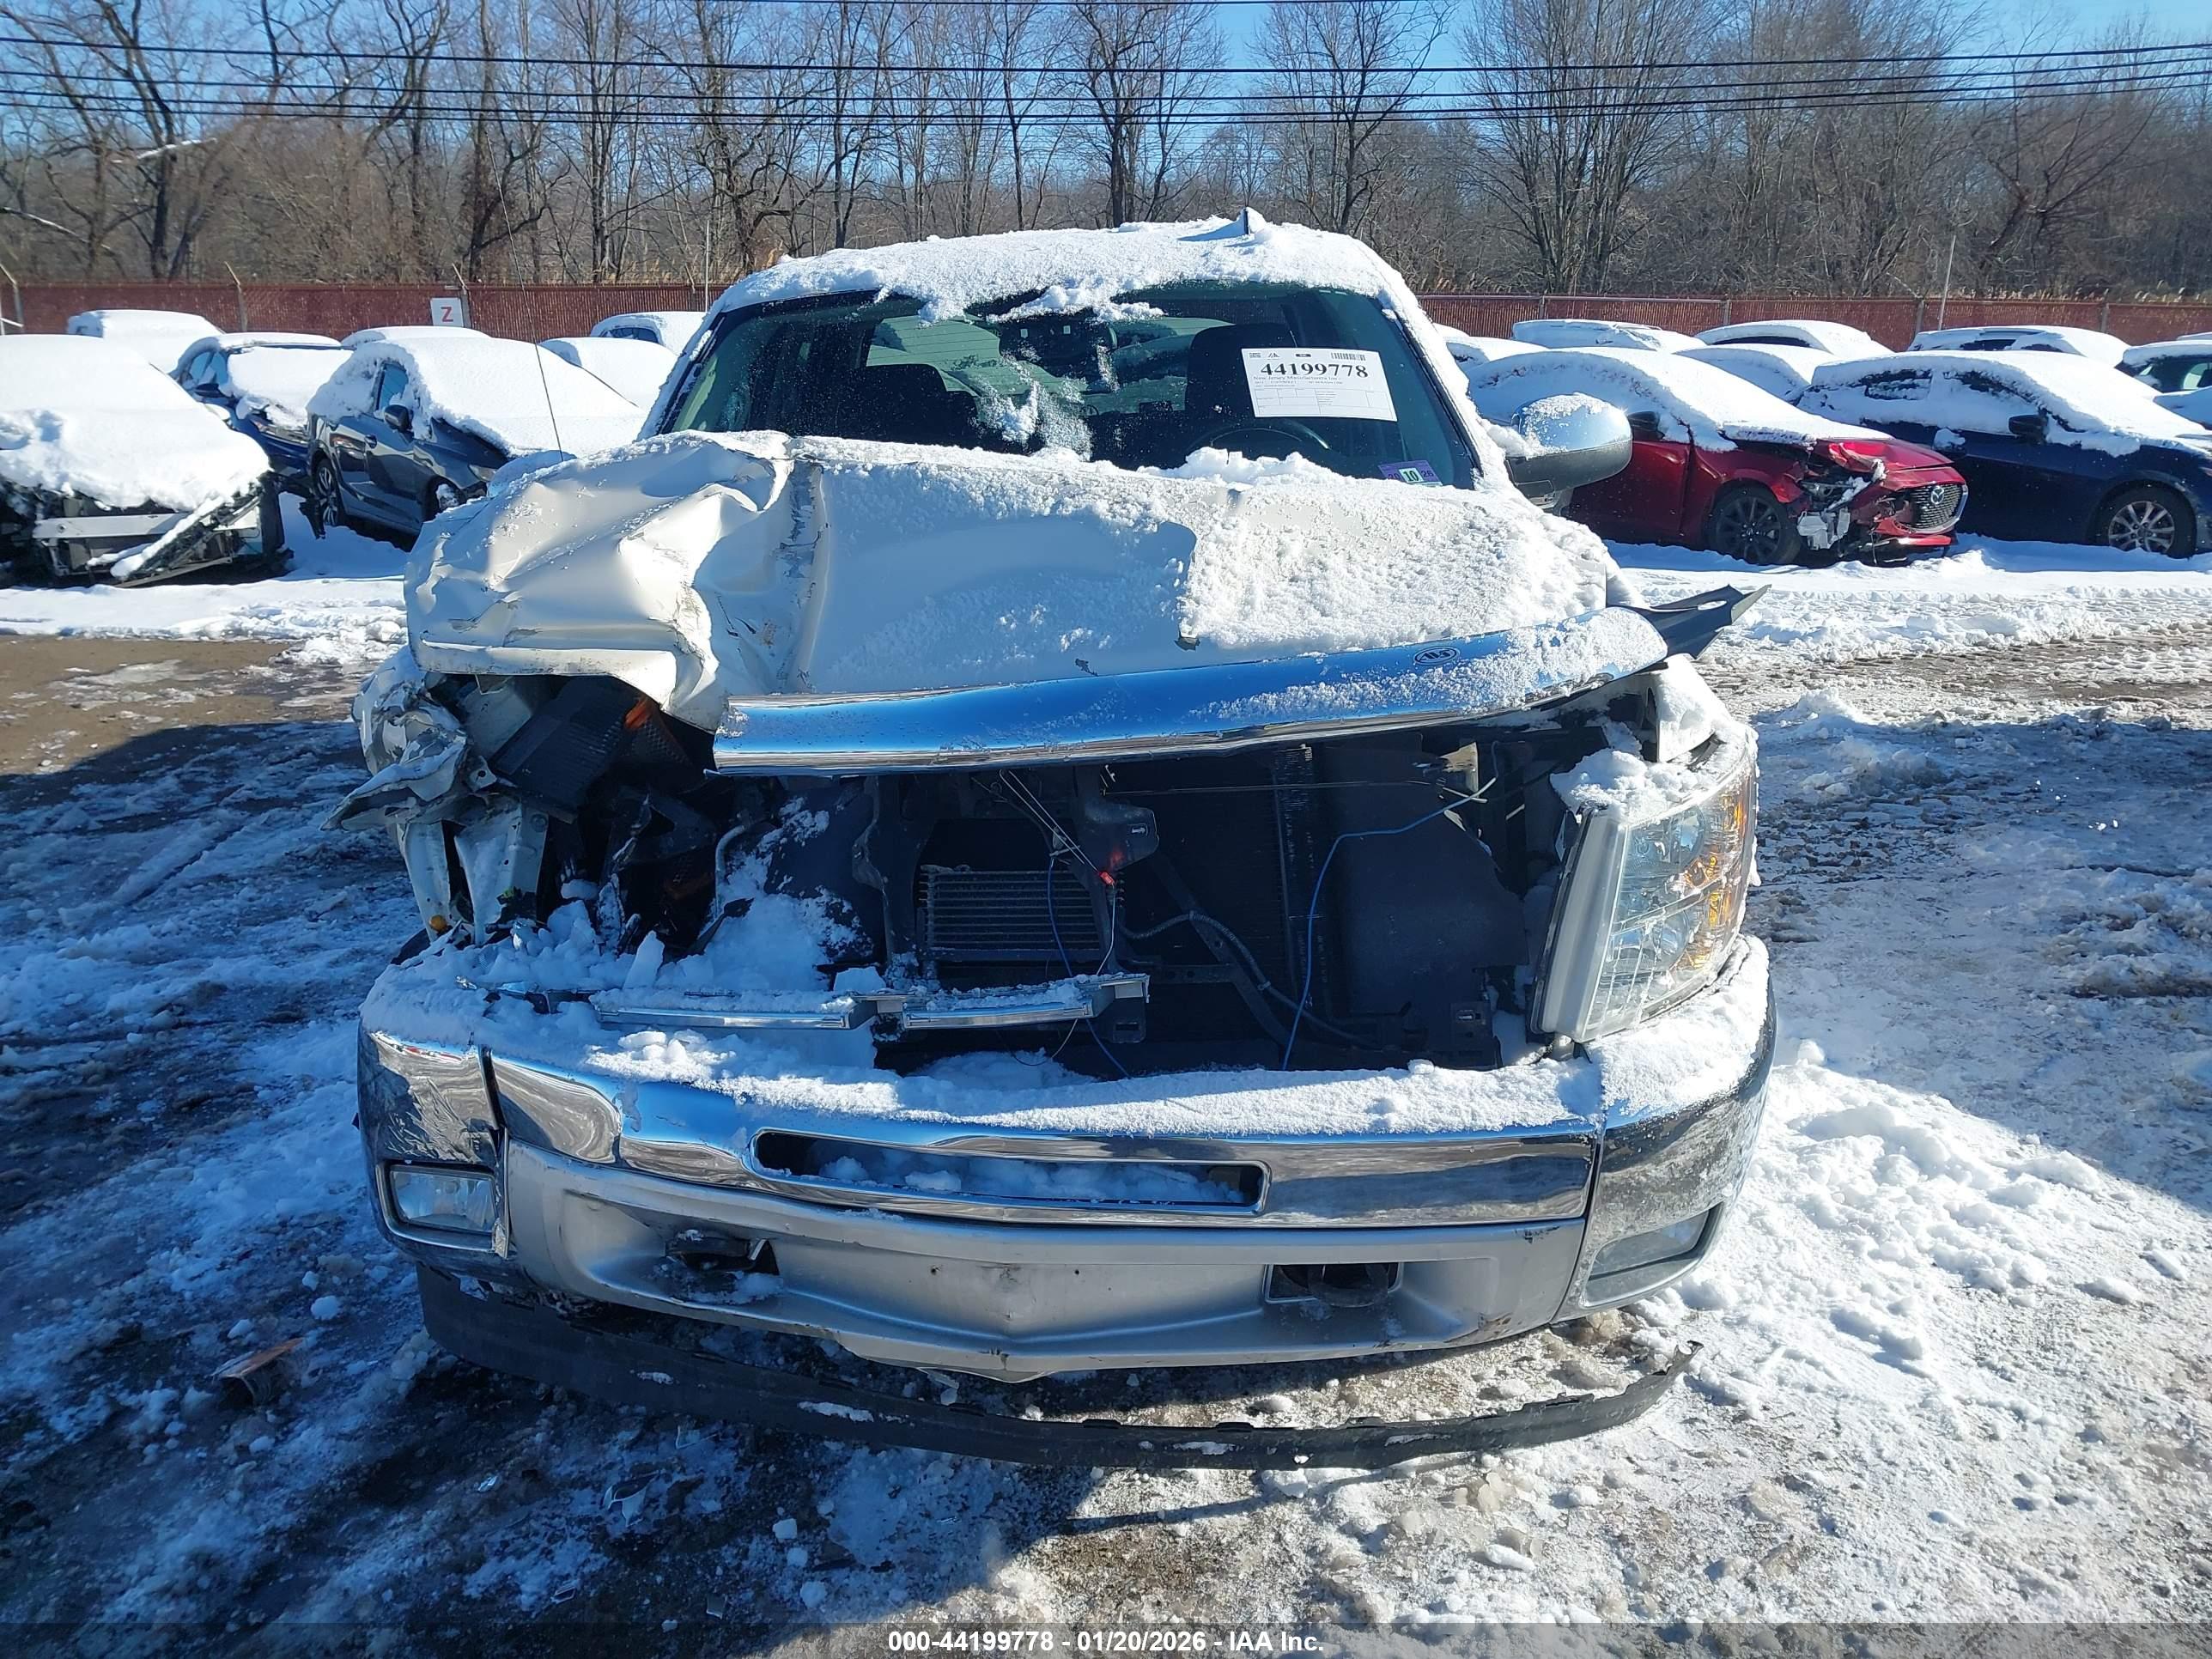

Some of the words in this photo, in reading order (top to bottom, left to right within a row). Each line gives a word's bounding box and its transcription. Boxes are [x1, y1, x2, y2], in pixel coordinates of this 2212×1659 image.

[441, 307, 454, 323] Z
[1260, 362, 1369, 379] 44199778
[1402, 471, 1419, 483] 10
